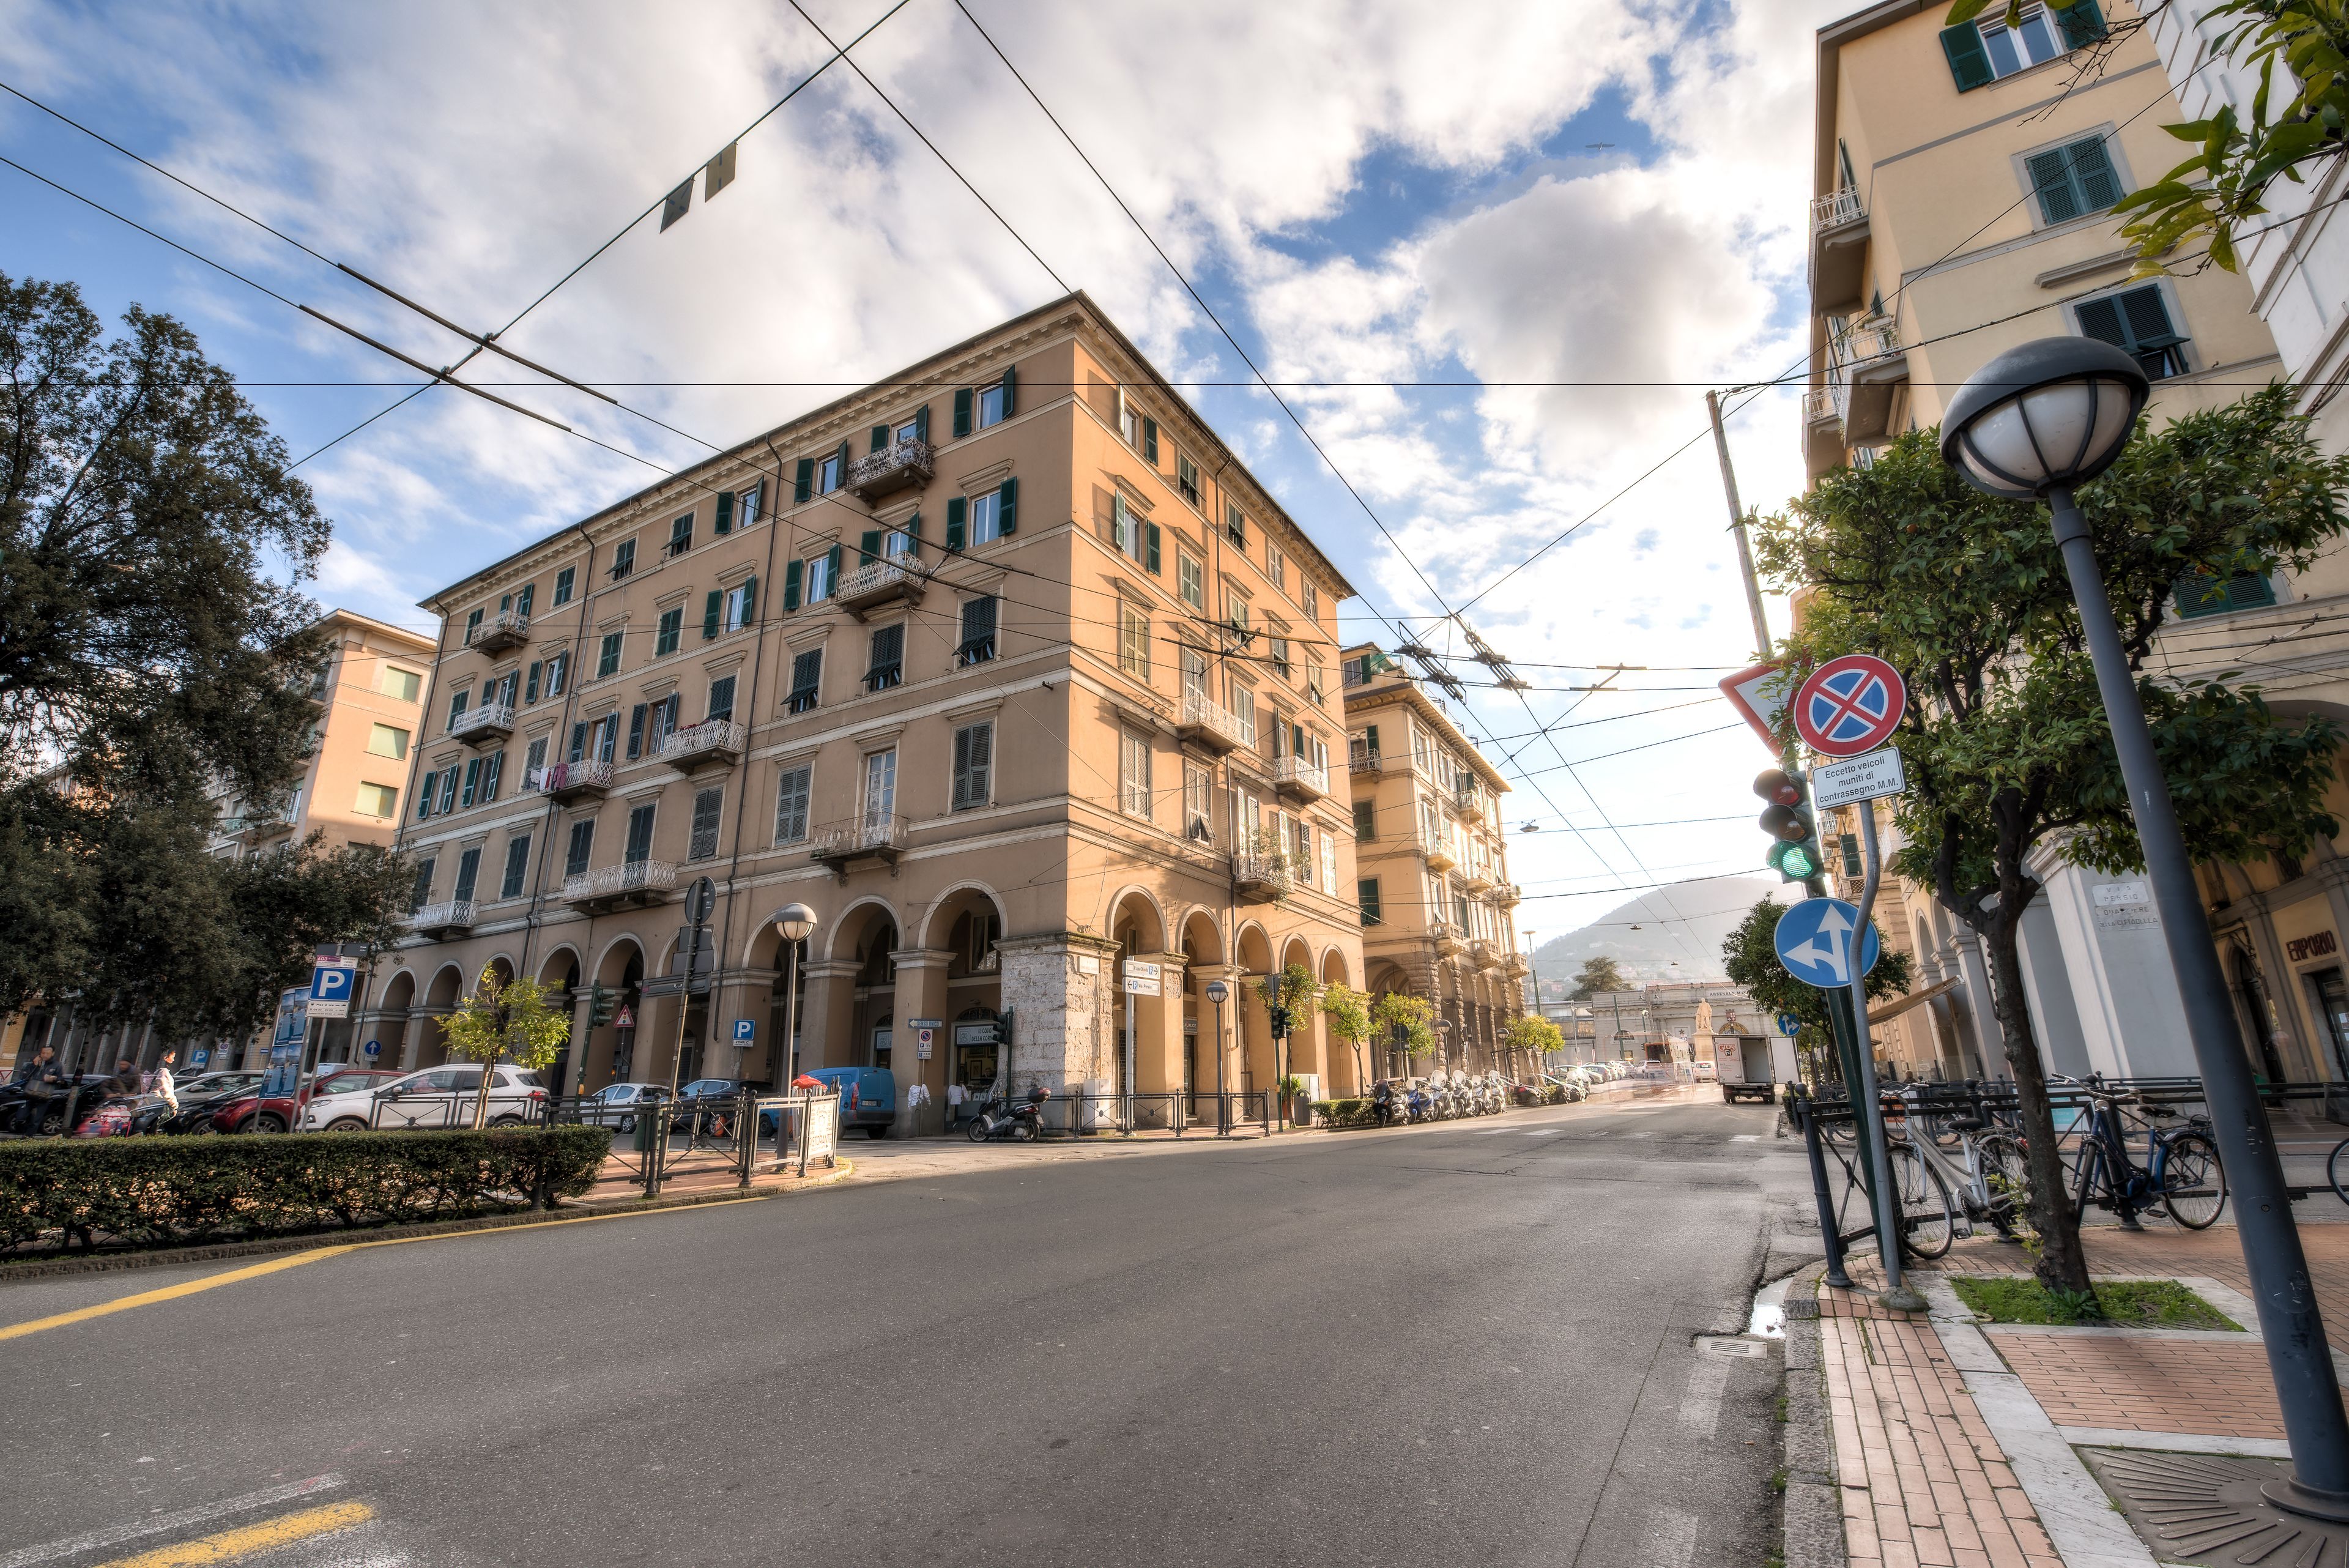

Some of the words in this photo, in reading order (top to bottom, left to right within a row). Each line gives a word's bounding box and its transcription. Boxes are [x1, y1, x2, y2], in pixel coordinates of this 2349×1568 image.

[1825, 765, 1855, 779] Eccetto
[1857, 756, 1885, 770] veicoli
[1838, 775, 1864, 787] muniti
[1866, 771, 1874, 780] di
[1819, 784, 1876, 803] contrassegno
[1877, 778, 1899, 789] M.M.
[2285, 930, 2337, 962] EMPORIO
[318, 970, 345, 997] P
[737, 1022, 751, 1038] P
[195, 1051, 206, 1061] P
